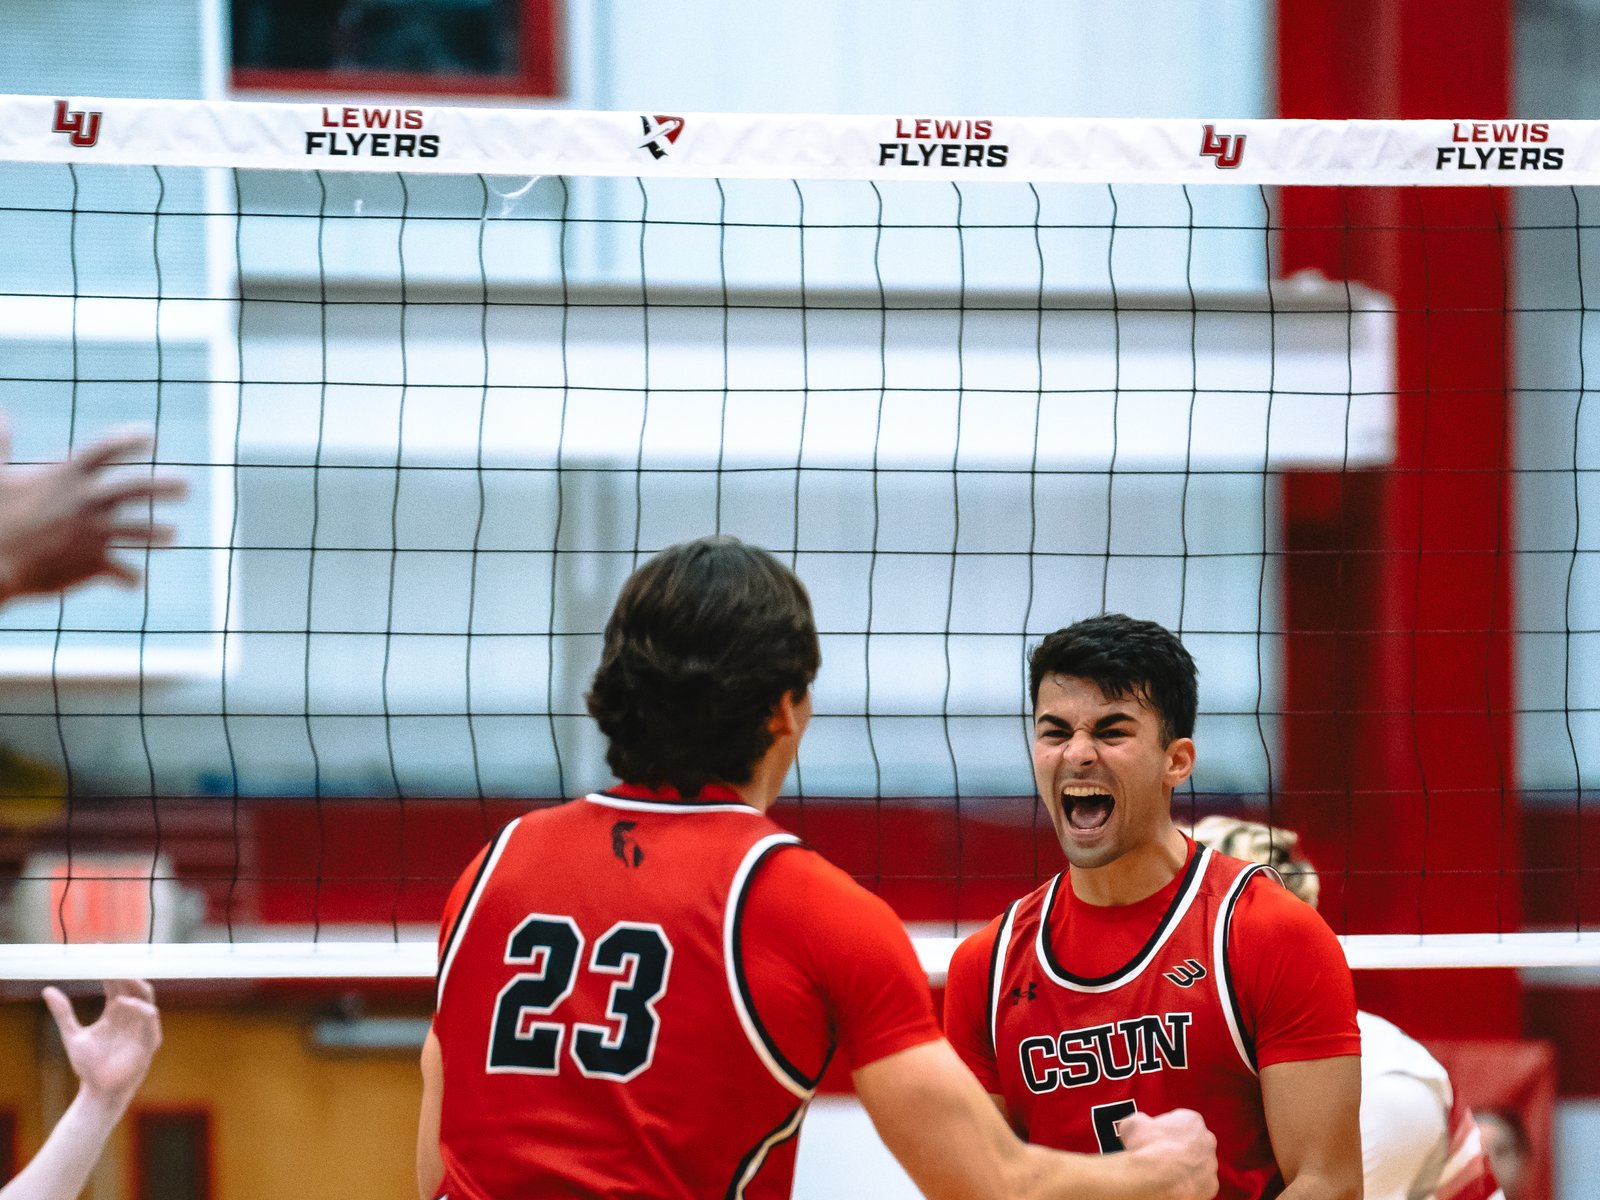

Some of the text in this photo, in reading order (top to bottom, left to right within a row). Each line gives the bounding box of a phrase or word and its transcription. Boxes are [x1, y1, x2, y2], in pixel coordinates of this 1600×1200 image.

[322, 107, 424, 130] LEWIS
[895, 118, 993, 140] LEWIS
[304, 131, 441, 158] FLYERS
[1452, 122, 1550, 143] LEWIS
[878, 143, 1009, 168] FLYERS
[1435, 146, 1565, 171] FLYERS
[485, 912, 673, 1083] 23
[1019, 1012, 1192, 1095] CSUN
